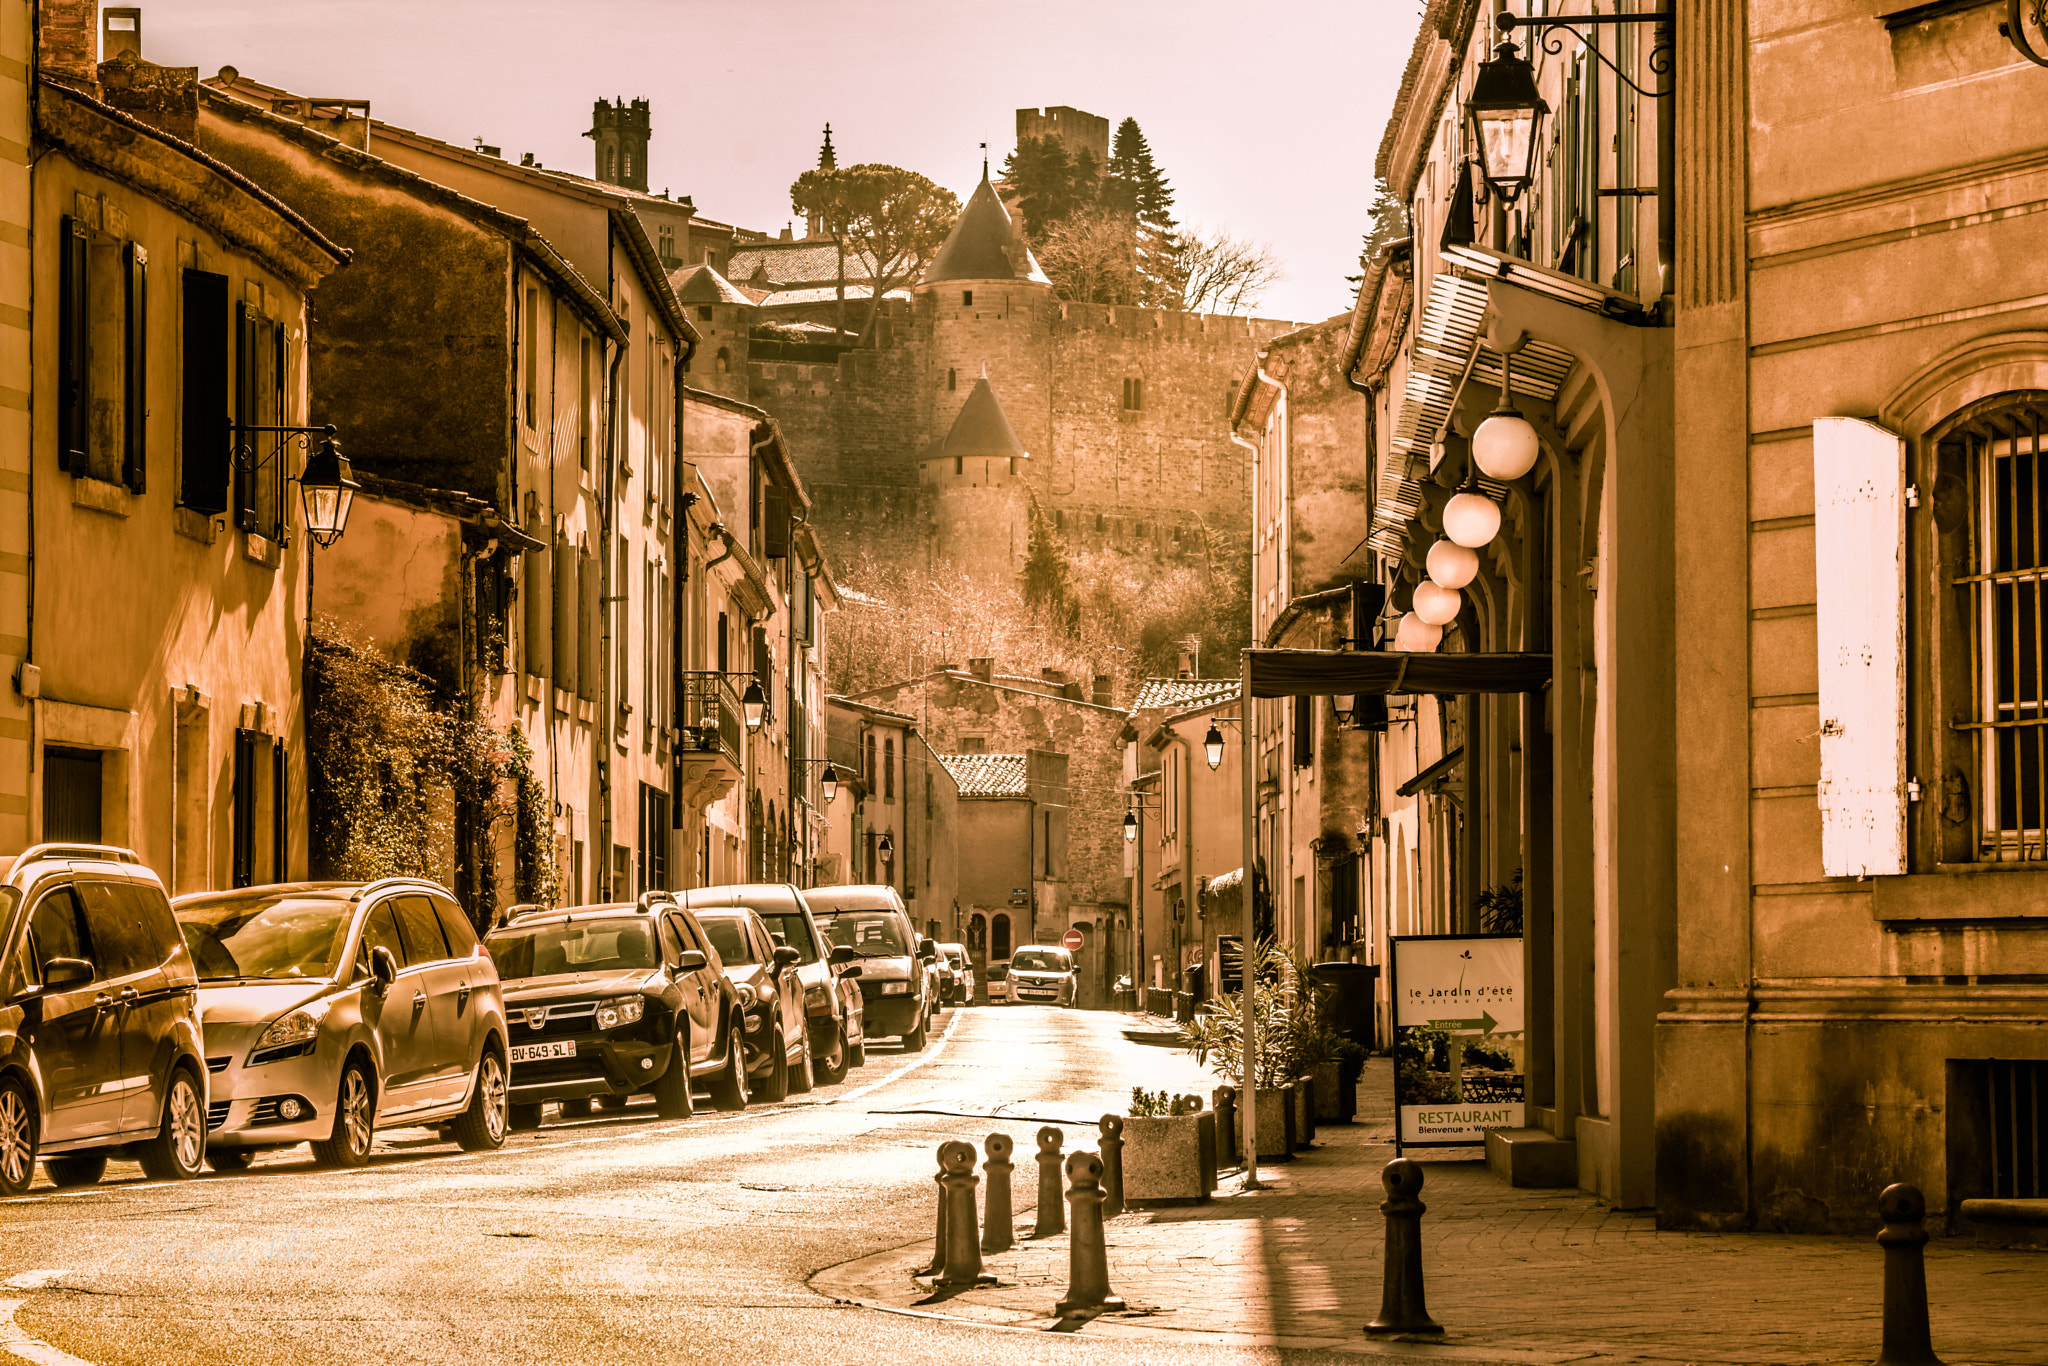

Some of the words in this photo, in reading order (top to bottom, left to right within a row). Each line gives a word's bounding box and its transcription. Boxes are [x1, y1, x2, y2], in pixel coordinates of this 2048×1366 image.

[1409, 988, 1422, 998] le
[1428, 987, 1471, 998] Jardin
[1478, 985, 1513, 996] d'été
[1410, 997, 1513, 1005] restaurant
[1434, 1020, 1463, 1029] Entrée
[1418, 1110, 1512, 1124] RESTAURANT
[1418, 1126, 1464, 1134] Bienvenue
